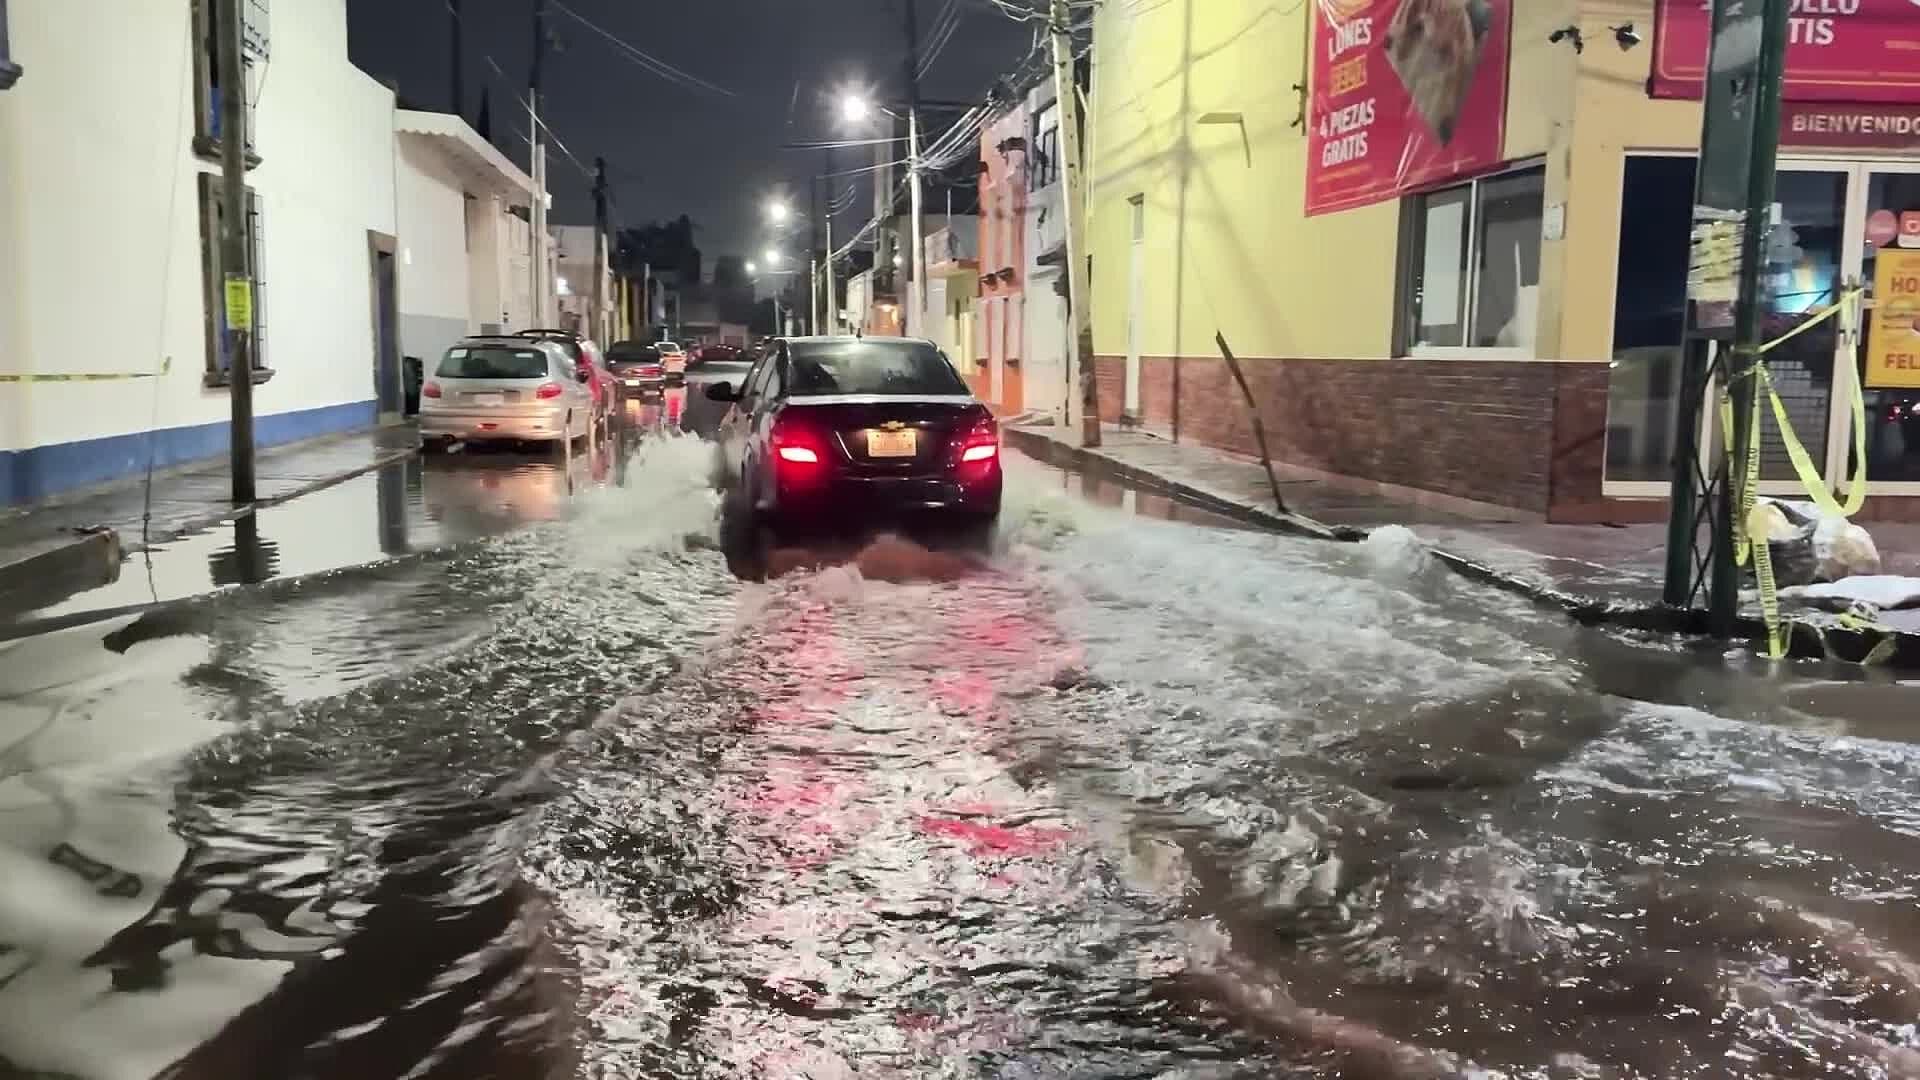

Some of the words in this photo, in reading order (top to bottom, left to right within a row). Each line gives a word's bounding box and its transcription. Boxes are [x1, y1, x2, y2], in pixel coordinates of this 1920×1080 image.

[1787, 18, 1835, 45] TIS
[1329, 97, 1377, 137] PIEZAS
[1322, 131, 1369, 169] GRATIS
